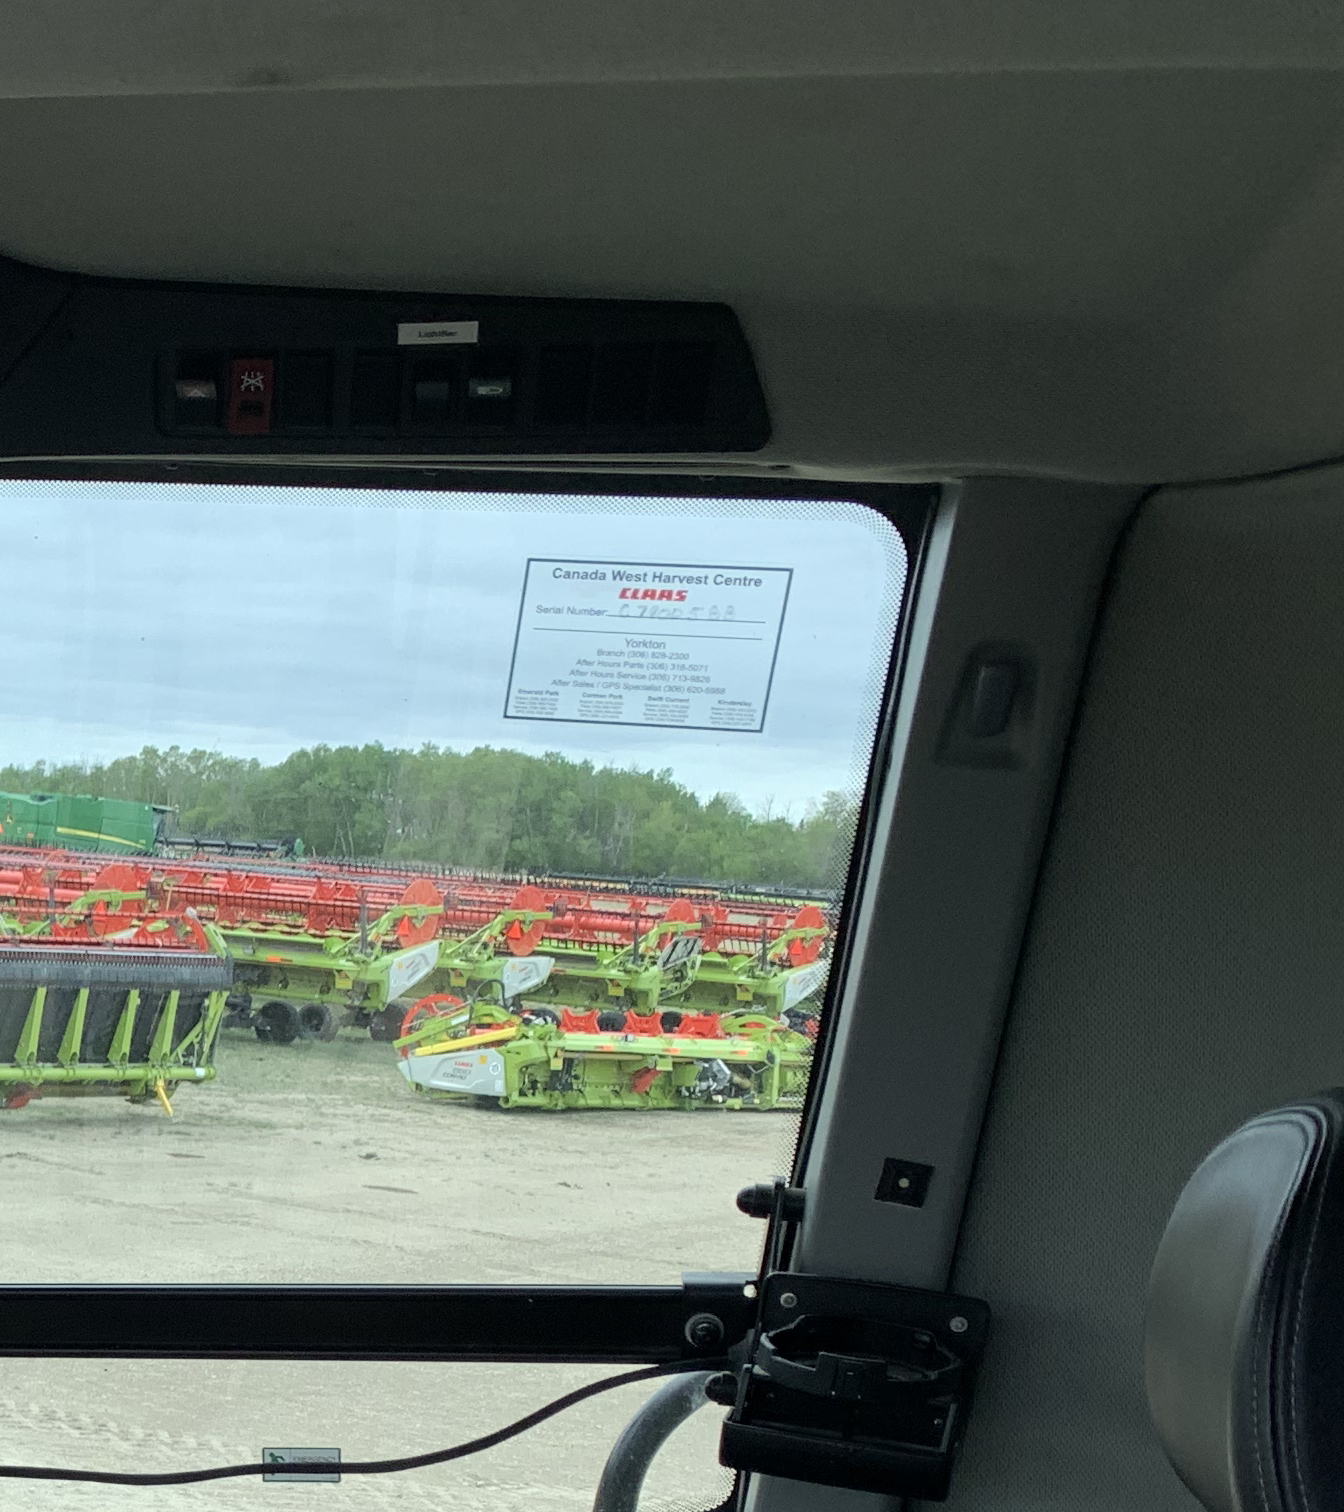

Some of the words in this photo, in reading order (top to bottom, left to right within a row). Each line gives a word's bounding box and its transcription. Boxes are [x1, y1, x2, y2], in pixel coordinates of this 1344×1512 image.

[552, 567, 606, 582] Canada
[612, 570, 648, 582] West
[652, 572, 708, 585] Harvest
[713, 574, 762, 588] Centre
[618, 588, 688, 602] CLAAS
[536, 604, 564, 615] Serial
[624, 638, 666, 650] Yorkton
[597, 649, 625, 658] Branch
[576, 658, 595, 668] After
[597, 660, 620, 669] Hours
[623, 661, 644, 670] Parts
[569, 669, 589, 678] After
[590, 670, 614, 679] Hours
[616, 672, 646, 681] Service
[551, 678, 571, 688] After
[602, 682, 620, 690] GPS
